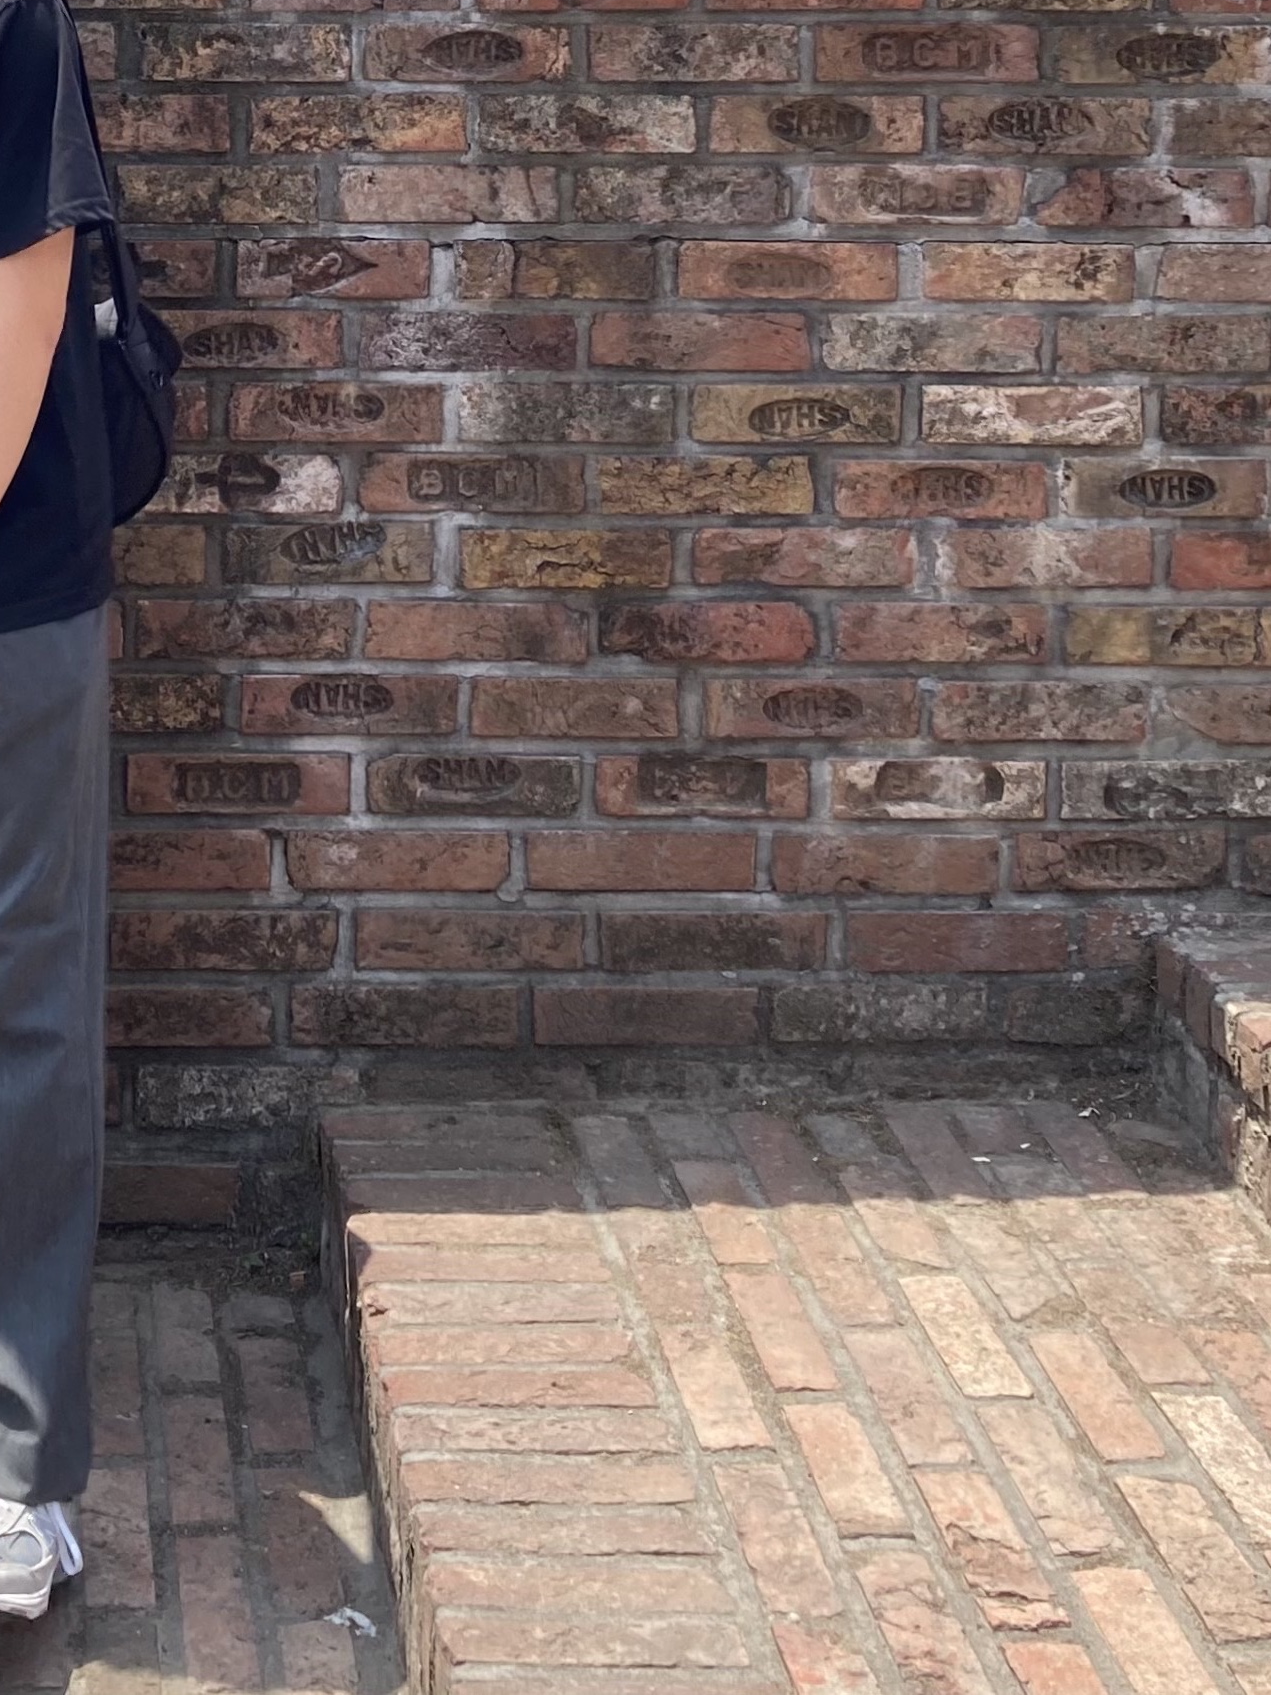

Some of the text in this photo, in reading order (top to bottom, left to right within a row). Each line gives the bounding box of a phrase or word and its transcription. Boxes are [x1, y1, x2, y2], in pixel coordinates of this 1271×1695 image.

[752, 403, 846, 433] SHAN
[1123, 471, 1215, 504] SHAN
[292, 684, 390, 717] SHAN
[424, 756, 509, 785] SHAN
